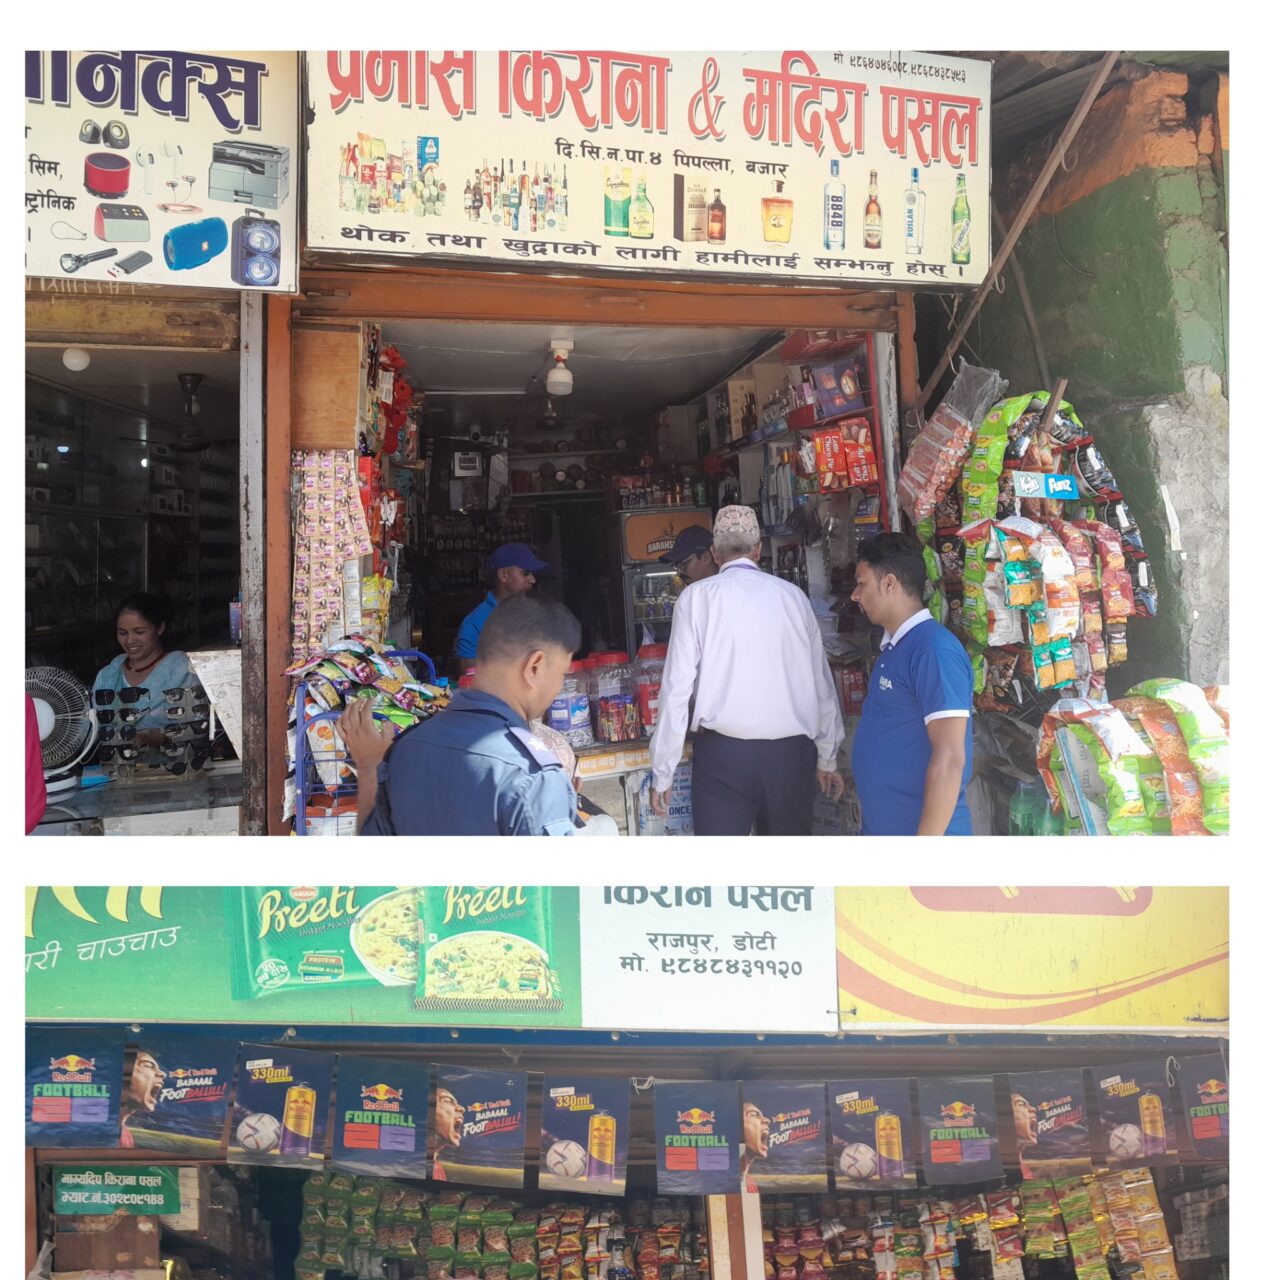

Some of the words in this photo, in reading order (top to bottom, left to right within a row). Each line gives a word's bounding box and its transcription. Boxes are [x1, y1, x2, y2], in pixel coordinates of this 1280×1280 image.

[687, 57, 724, 138] &
[742, 51, 867, 154] मदिरा
[880, 85, 982, 166] पसल
[746, 160, 790, 178] बजार
[831, 195, 843, 228] 8848
[340, 225, 411, 244] थोक
[426, 232, 487, 249] तथा
[616, 245, 681, 263] लागी
[696, 249, 800, 270] हामीलाई
[258, 886, 360, 940] Preeti
[76, 926, 182, 961] चाउचाउ
[646, 931, 719, 954] राजपुर,
[733, 931, 777, 952] डोटी
[620, 953, 649, 973] मो.
[52, 1072, 72, 1082] Red
[73, 1072, 92, 1082] Bull
[251, 1065, 291, 1080] 330ml
[33, 1083, 110, 1098] FOOTBALL
[556, 1095, 592, 1108] 330ml
[843, 1097, 875, 1113] 330ml
[345, 1111, 416, 1127] FOOTBALL
[665, 1135, 729, 1147] FOOTBALL
[930, 1127, 989, 1140] FOOTBALL
[139, 1174, 162, 1187] पसल
